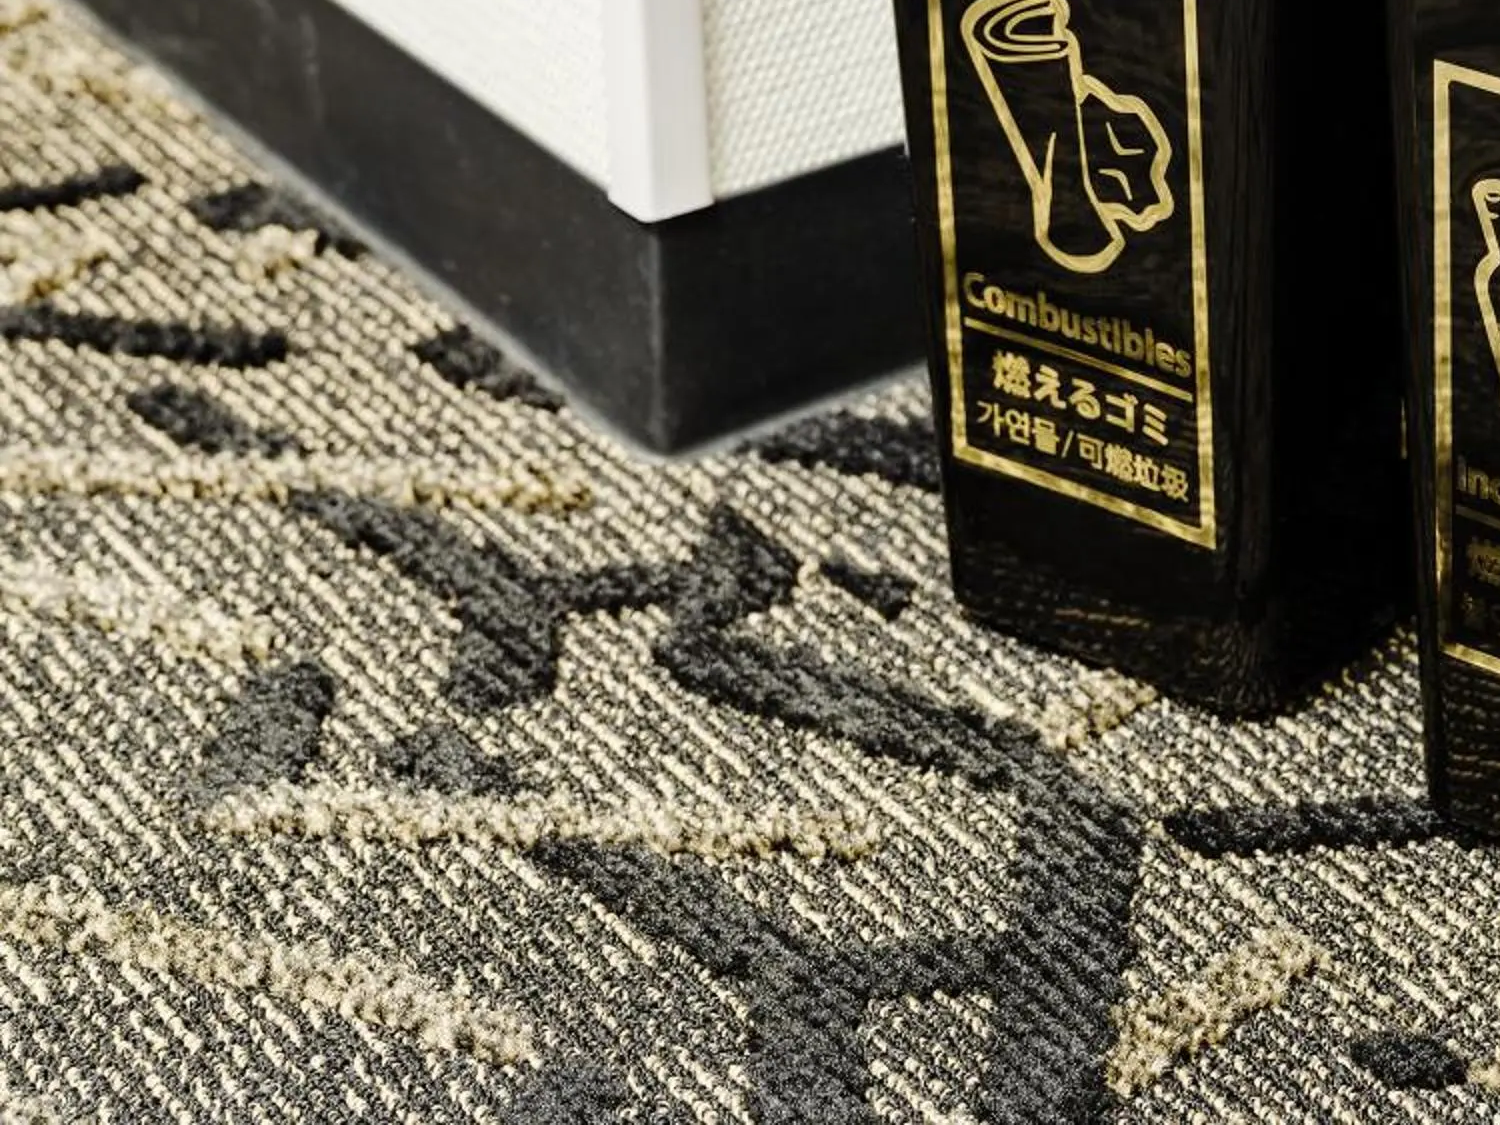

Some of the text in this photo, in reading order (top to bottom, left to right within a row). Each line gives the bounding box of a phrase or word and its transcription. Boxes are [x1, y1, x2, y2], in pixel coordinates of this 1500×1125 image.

[963, 272, 1192, 377] Combustibles
[992, 349, 1168, 446] 燃えるゴミ
